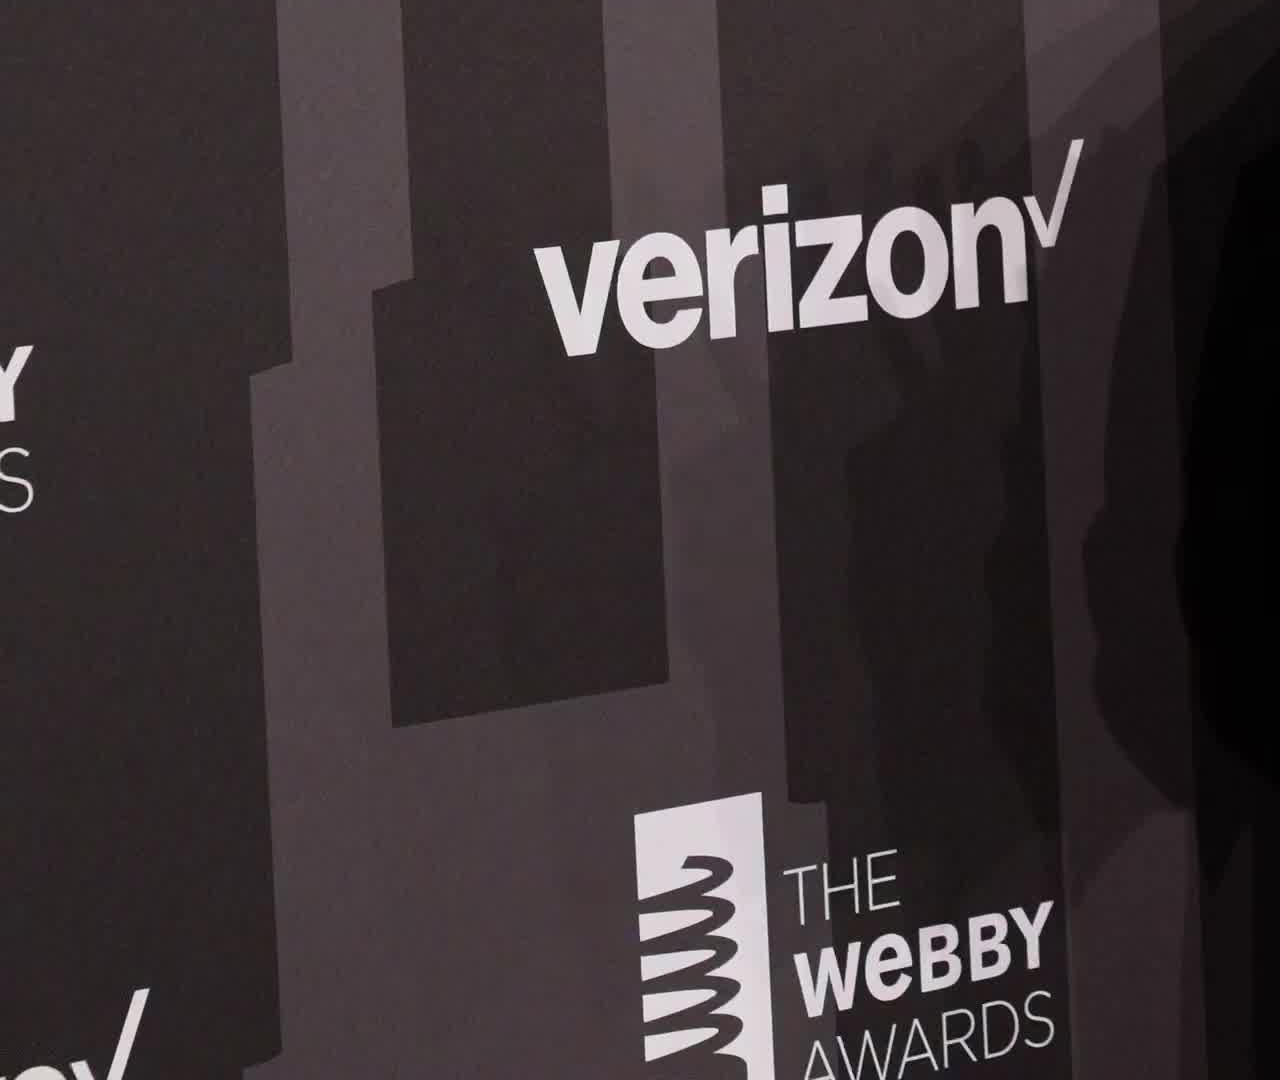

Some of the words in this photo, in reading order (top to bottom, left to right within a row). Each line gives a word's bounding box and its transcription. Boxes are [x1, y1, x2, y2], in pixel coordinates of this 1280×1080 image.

[533, 183, 1029, 357] verizon
[783, 849, 901, 926] THE
[793, 900, 1055, 1019] WeBBY
[803, 990, 1055, 1080] AWARDS
